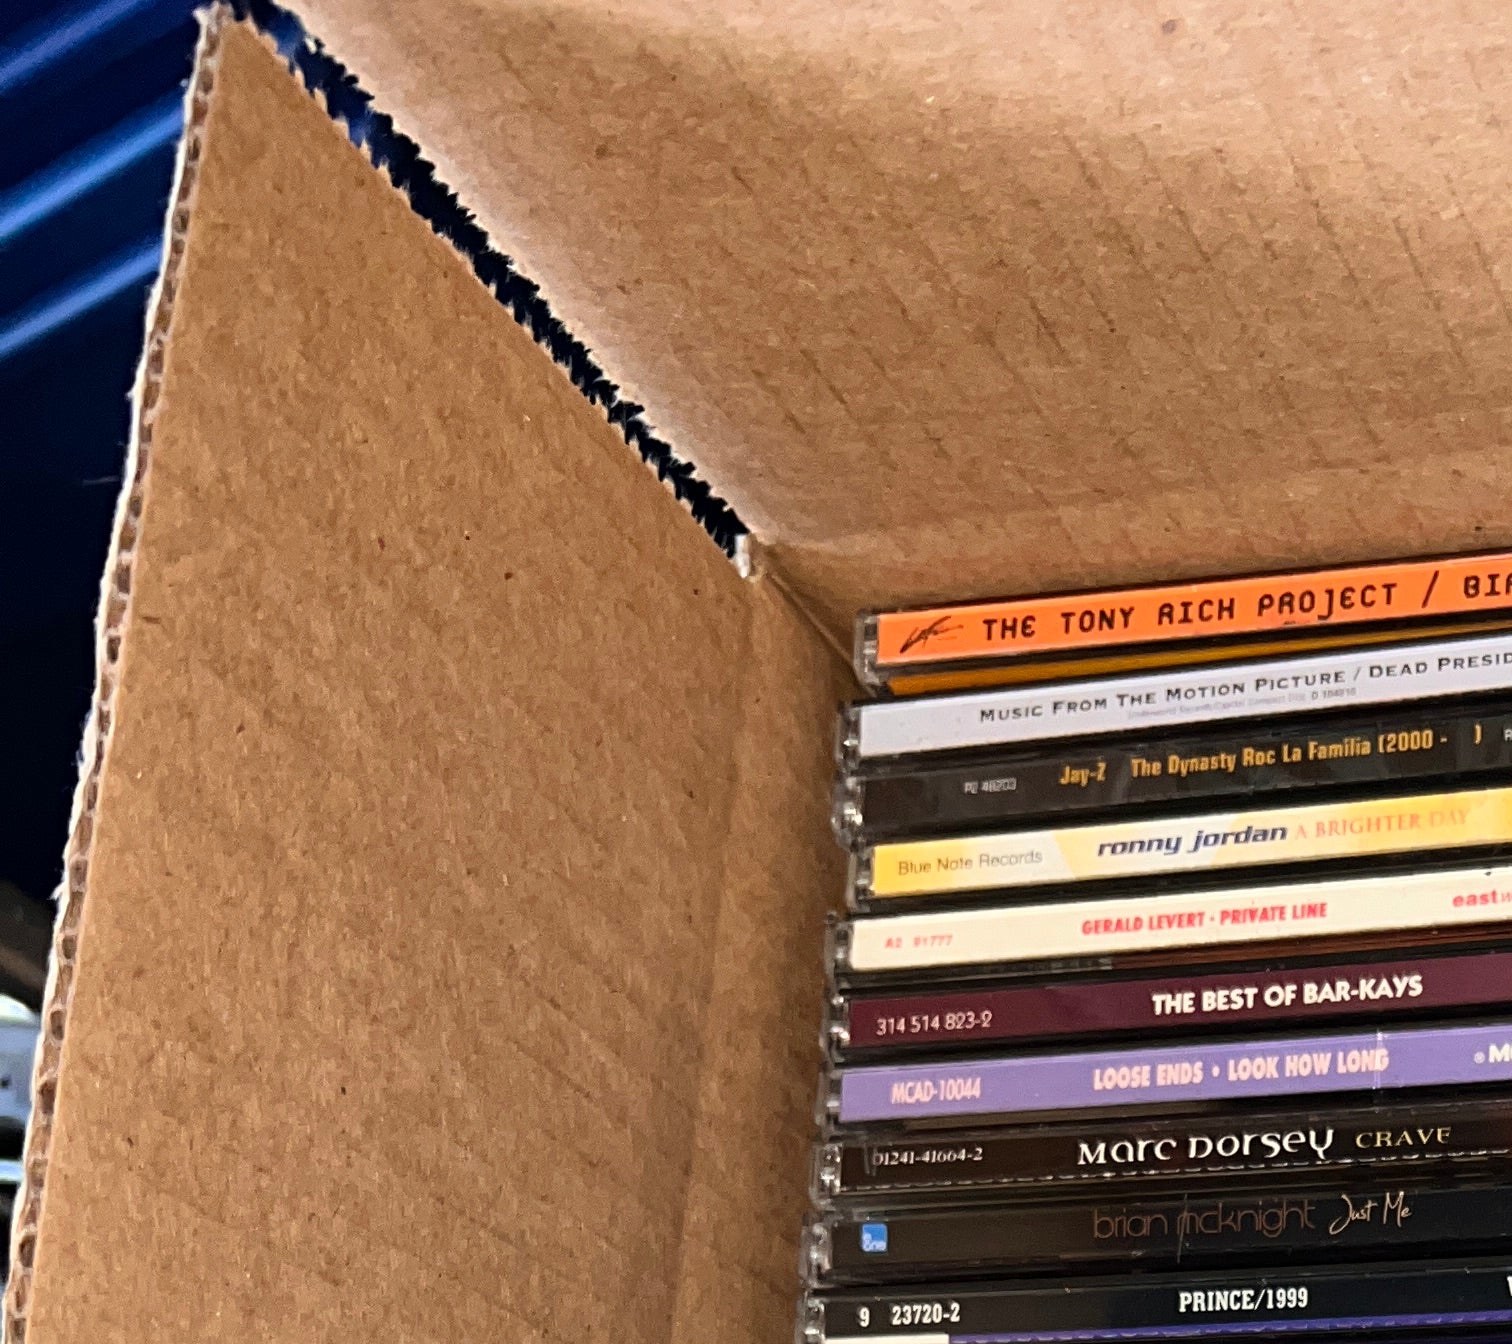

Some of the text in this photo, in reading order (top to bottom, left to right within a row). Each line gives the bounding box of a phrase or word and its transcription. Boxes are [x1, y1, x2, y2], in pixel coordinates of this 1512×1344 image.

[983, 616, 1035, 640] THE
[1061, 606, 1134, 634] TONY
[1158, 597, 1235, 625] RICH
[1258, 583, 1397, 620] PROJECT
[1059, 739, 1371, 785] Jay-Z The Dynasty Roc La Familia
[1097, 826, 1287, 856] ronny jordan
[1152, 975, 1423, 1016] THE BEST OF BAR-KAYS
[1093, 1047, 1389, 1091] LOOSE ENDS LOOK HOW LONG
[892, 1302, 961, 1326] 23720-2
[1178, 1286, 1309, 1313] PRINCE/1999
